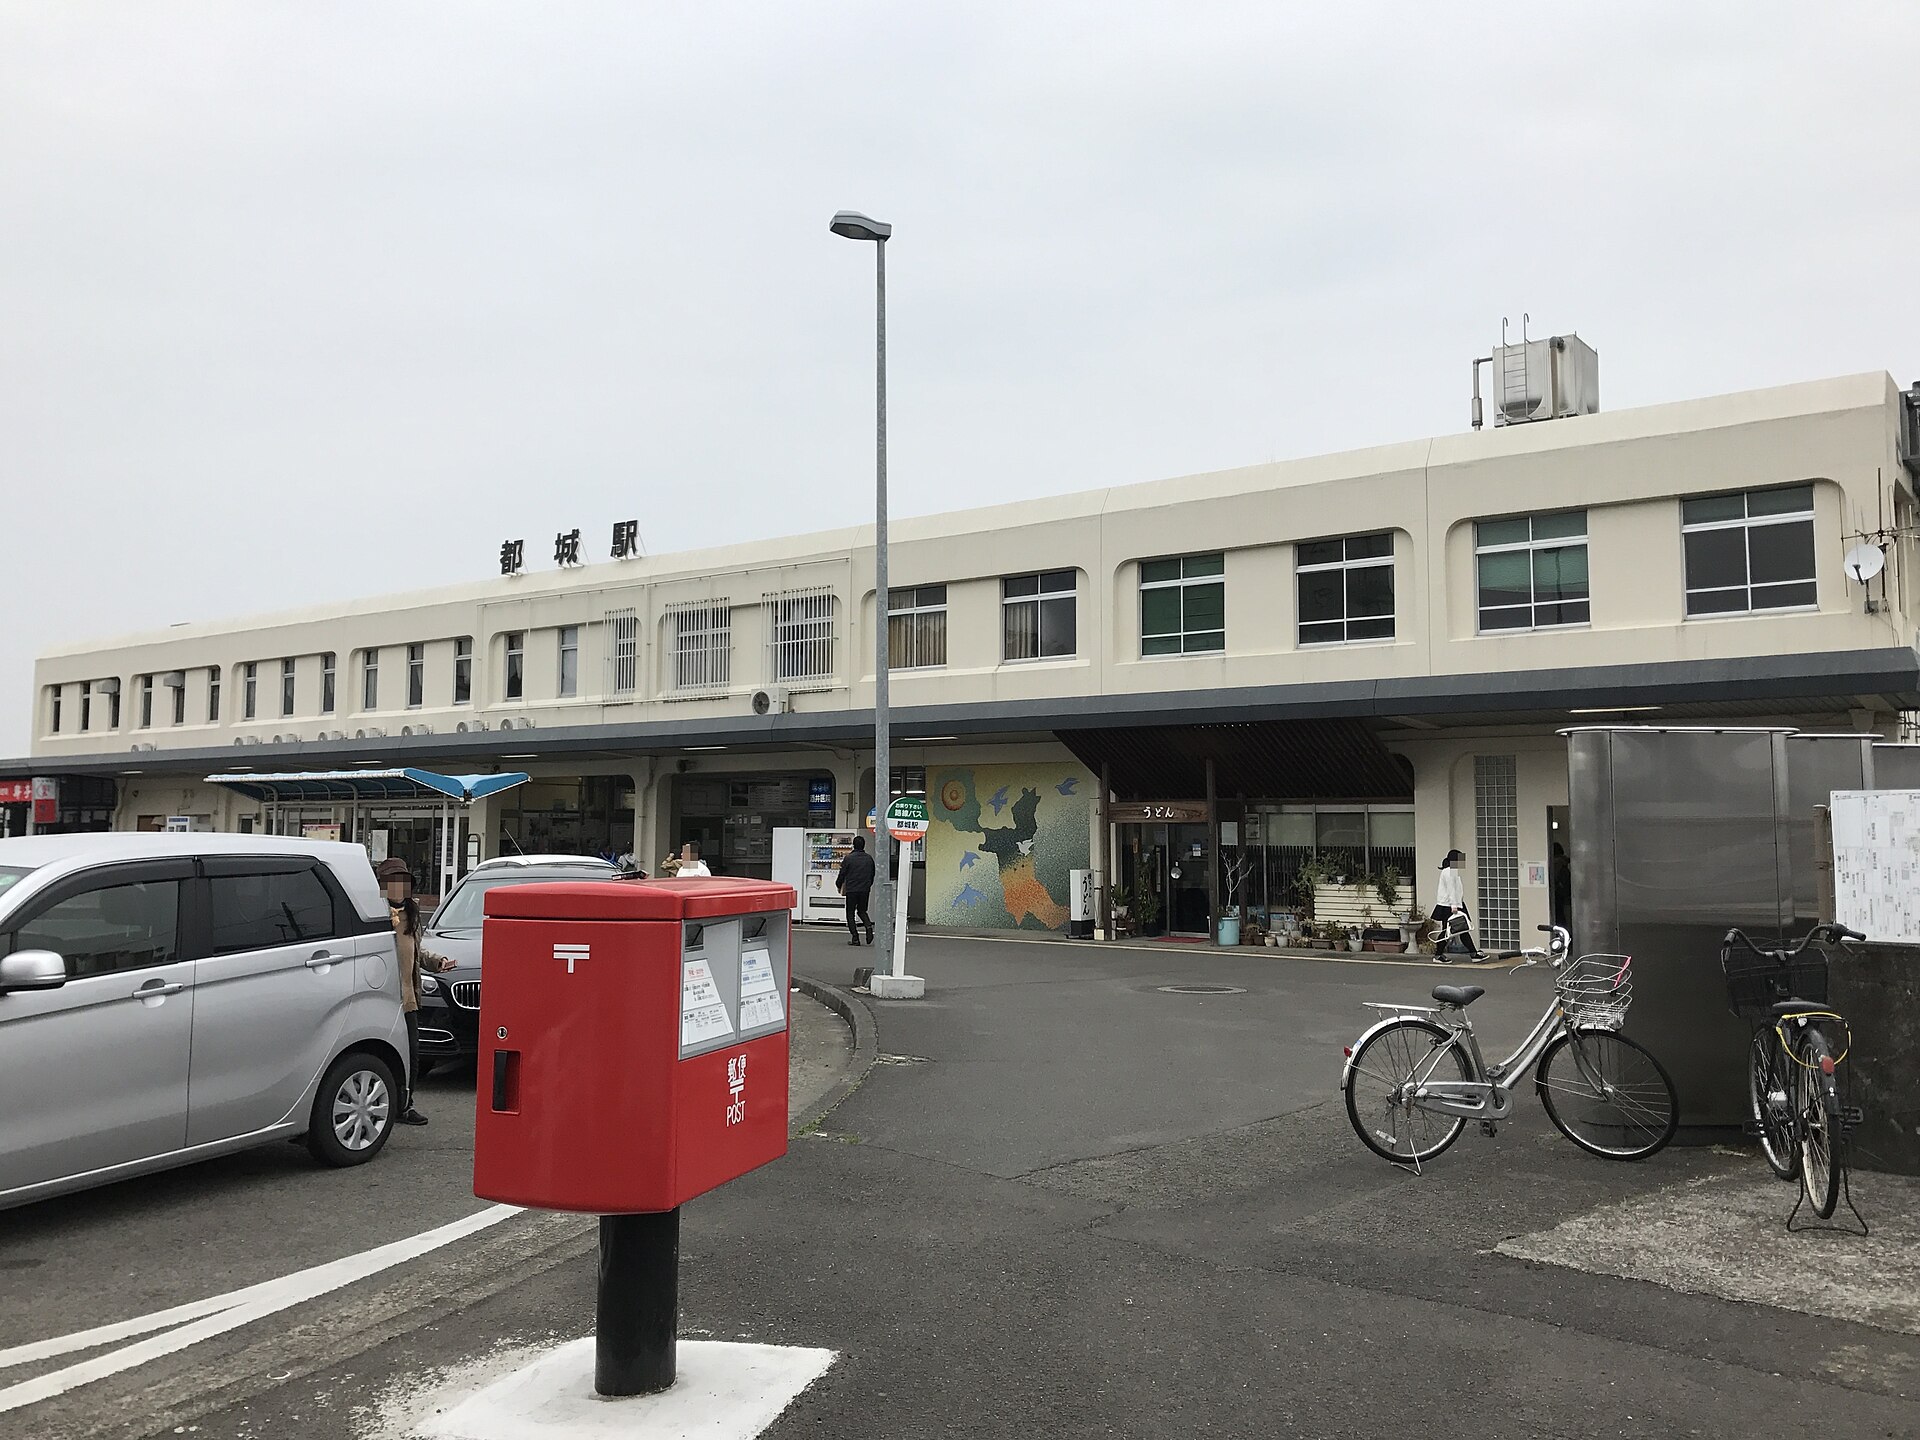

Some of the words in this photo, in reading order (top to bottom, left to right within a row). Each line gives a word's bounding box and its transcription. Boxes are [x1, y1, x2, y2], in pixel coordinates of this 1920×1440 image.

[500, 519, 638, 575] 都城駅
[894, 809, 923, 818] 路線バス
[896, 820, 919, 829] 都城駅
[1143, 806, 1175, 819] うどん
[1082, 876, 1090, 916] うどん
[727, 1054, 747, 1083] 郵便
[726, 1100, 746, 1128] POST
